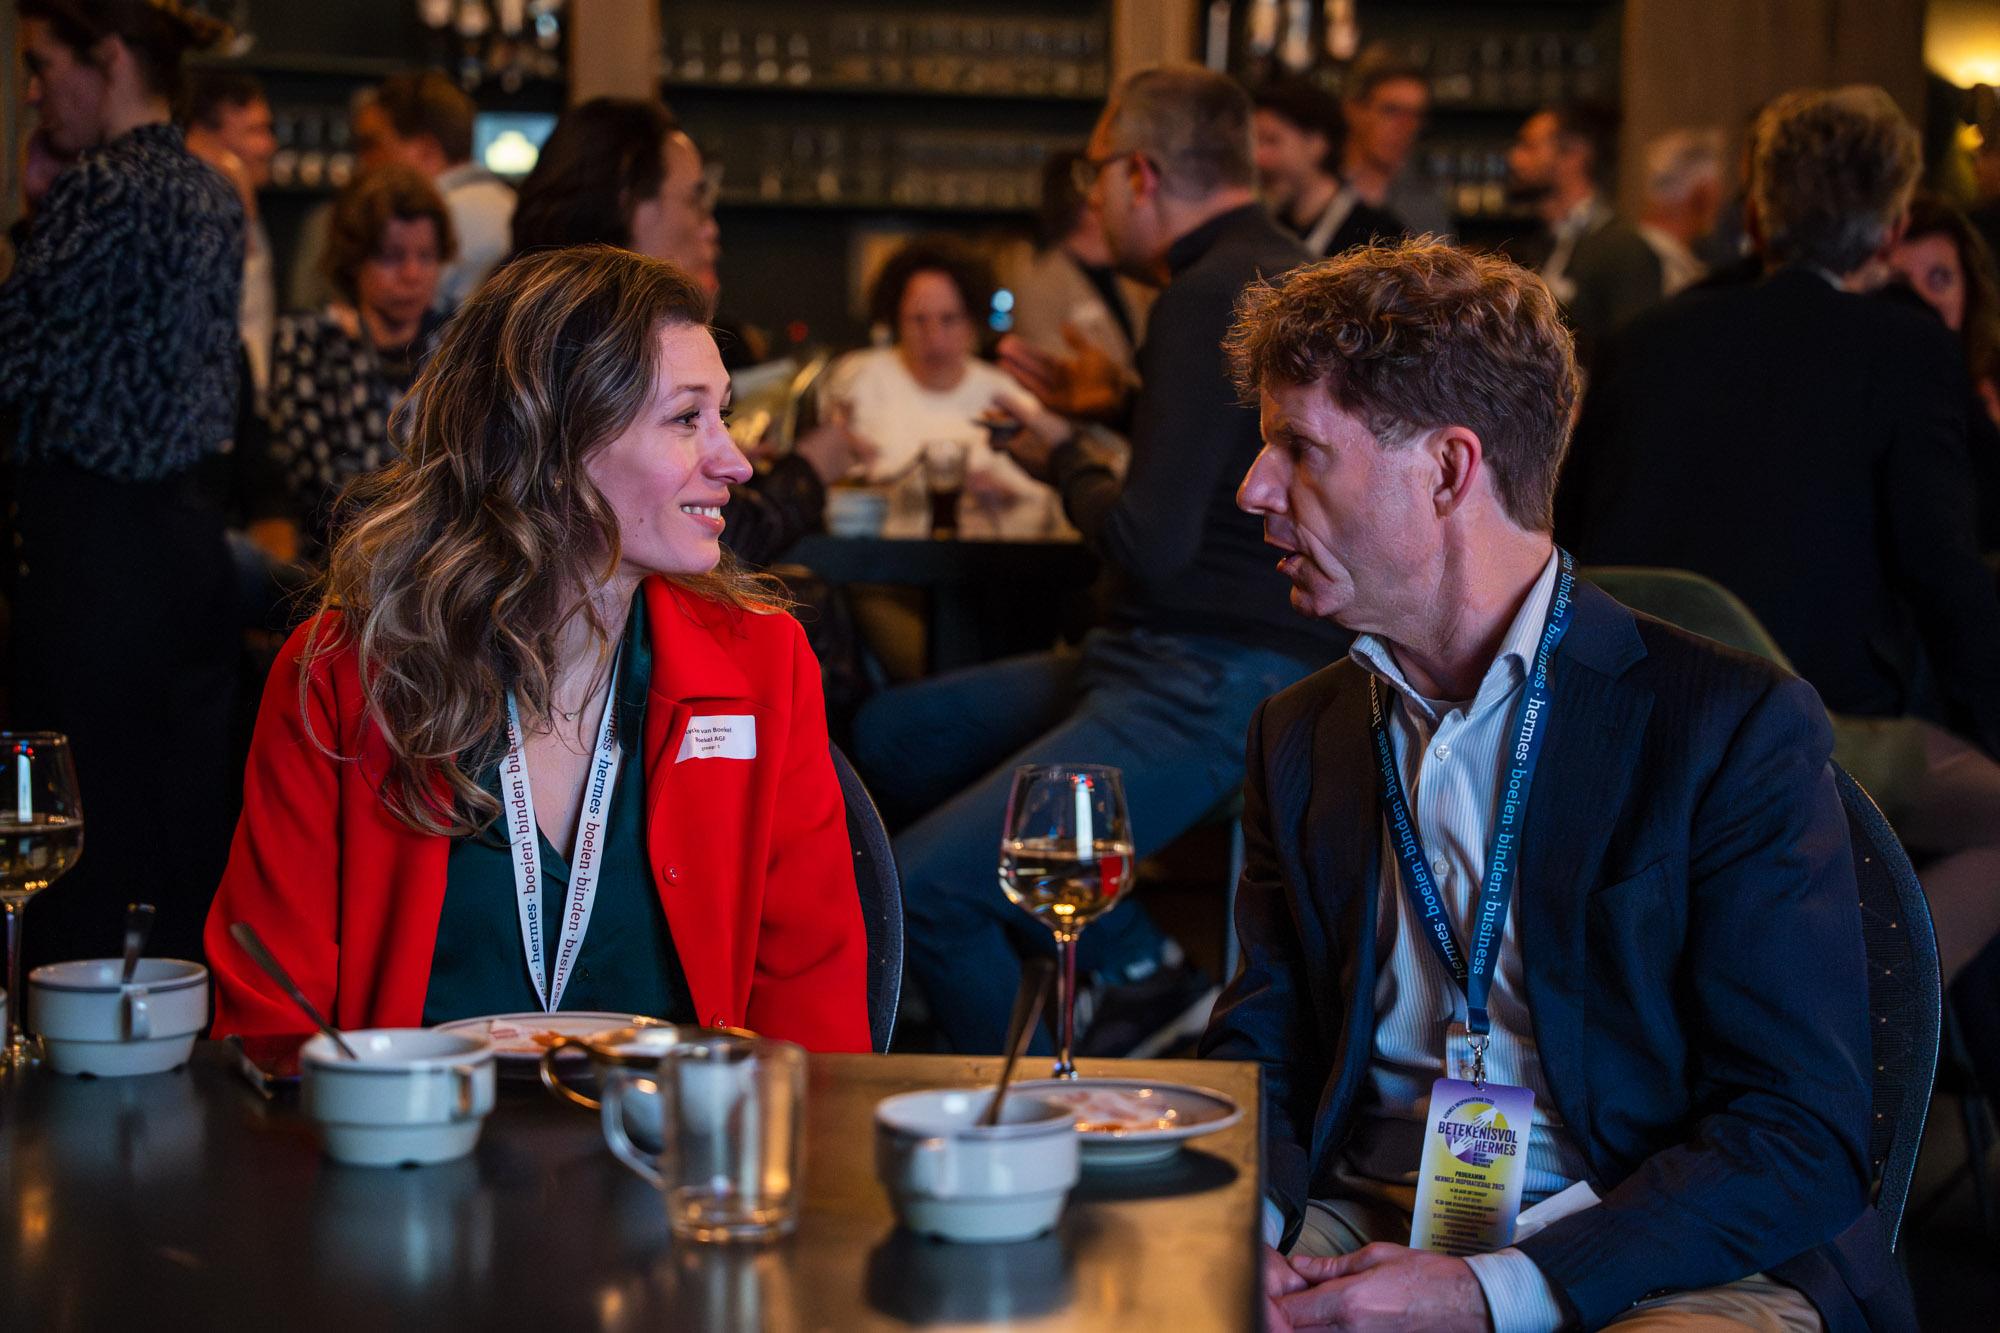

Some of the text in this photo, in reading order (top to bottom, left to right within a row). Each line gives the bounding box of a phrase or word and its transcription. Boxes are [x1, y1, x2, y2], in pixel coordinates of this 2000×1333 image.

[1553, 572, 1575, 619] binden
[1534, 622, 1560, 689] business
[1515, 697, 1545, 761] hermes
[589, 759, 613, 815] hermes
[1377, 730, 1398, 799] business
[511, 780, 530, 835] binden
[1502, 768, 1527, 825] boeien
[580, 822, 600, 873] boeien
[1392, 800, 1417, 859] binden
[520, 841, 536, 895] boeien
[1411, 861, 1440, 918] boeien
[1489, 832, 1514, 896] binden
[568, 877, 591, 931] binden
[527, 903, 540, 964] hermes
[1434, 922, 1468, 980] hermes
[1473, 900, 1501, 975] business
[552, 936, 578, 1007] business
[1437, 1121, 1518, 1144] BETEKENISVOL
[1474, 1140, 1517, 1156] HERMES
